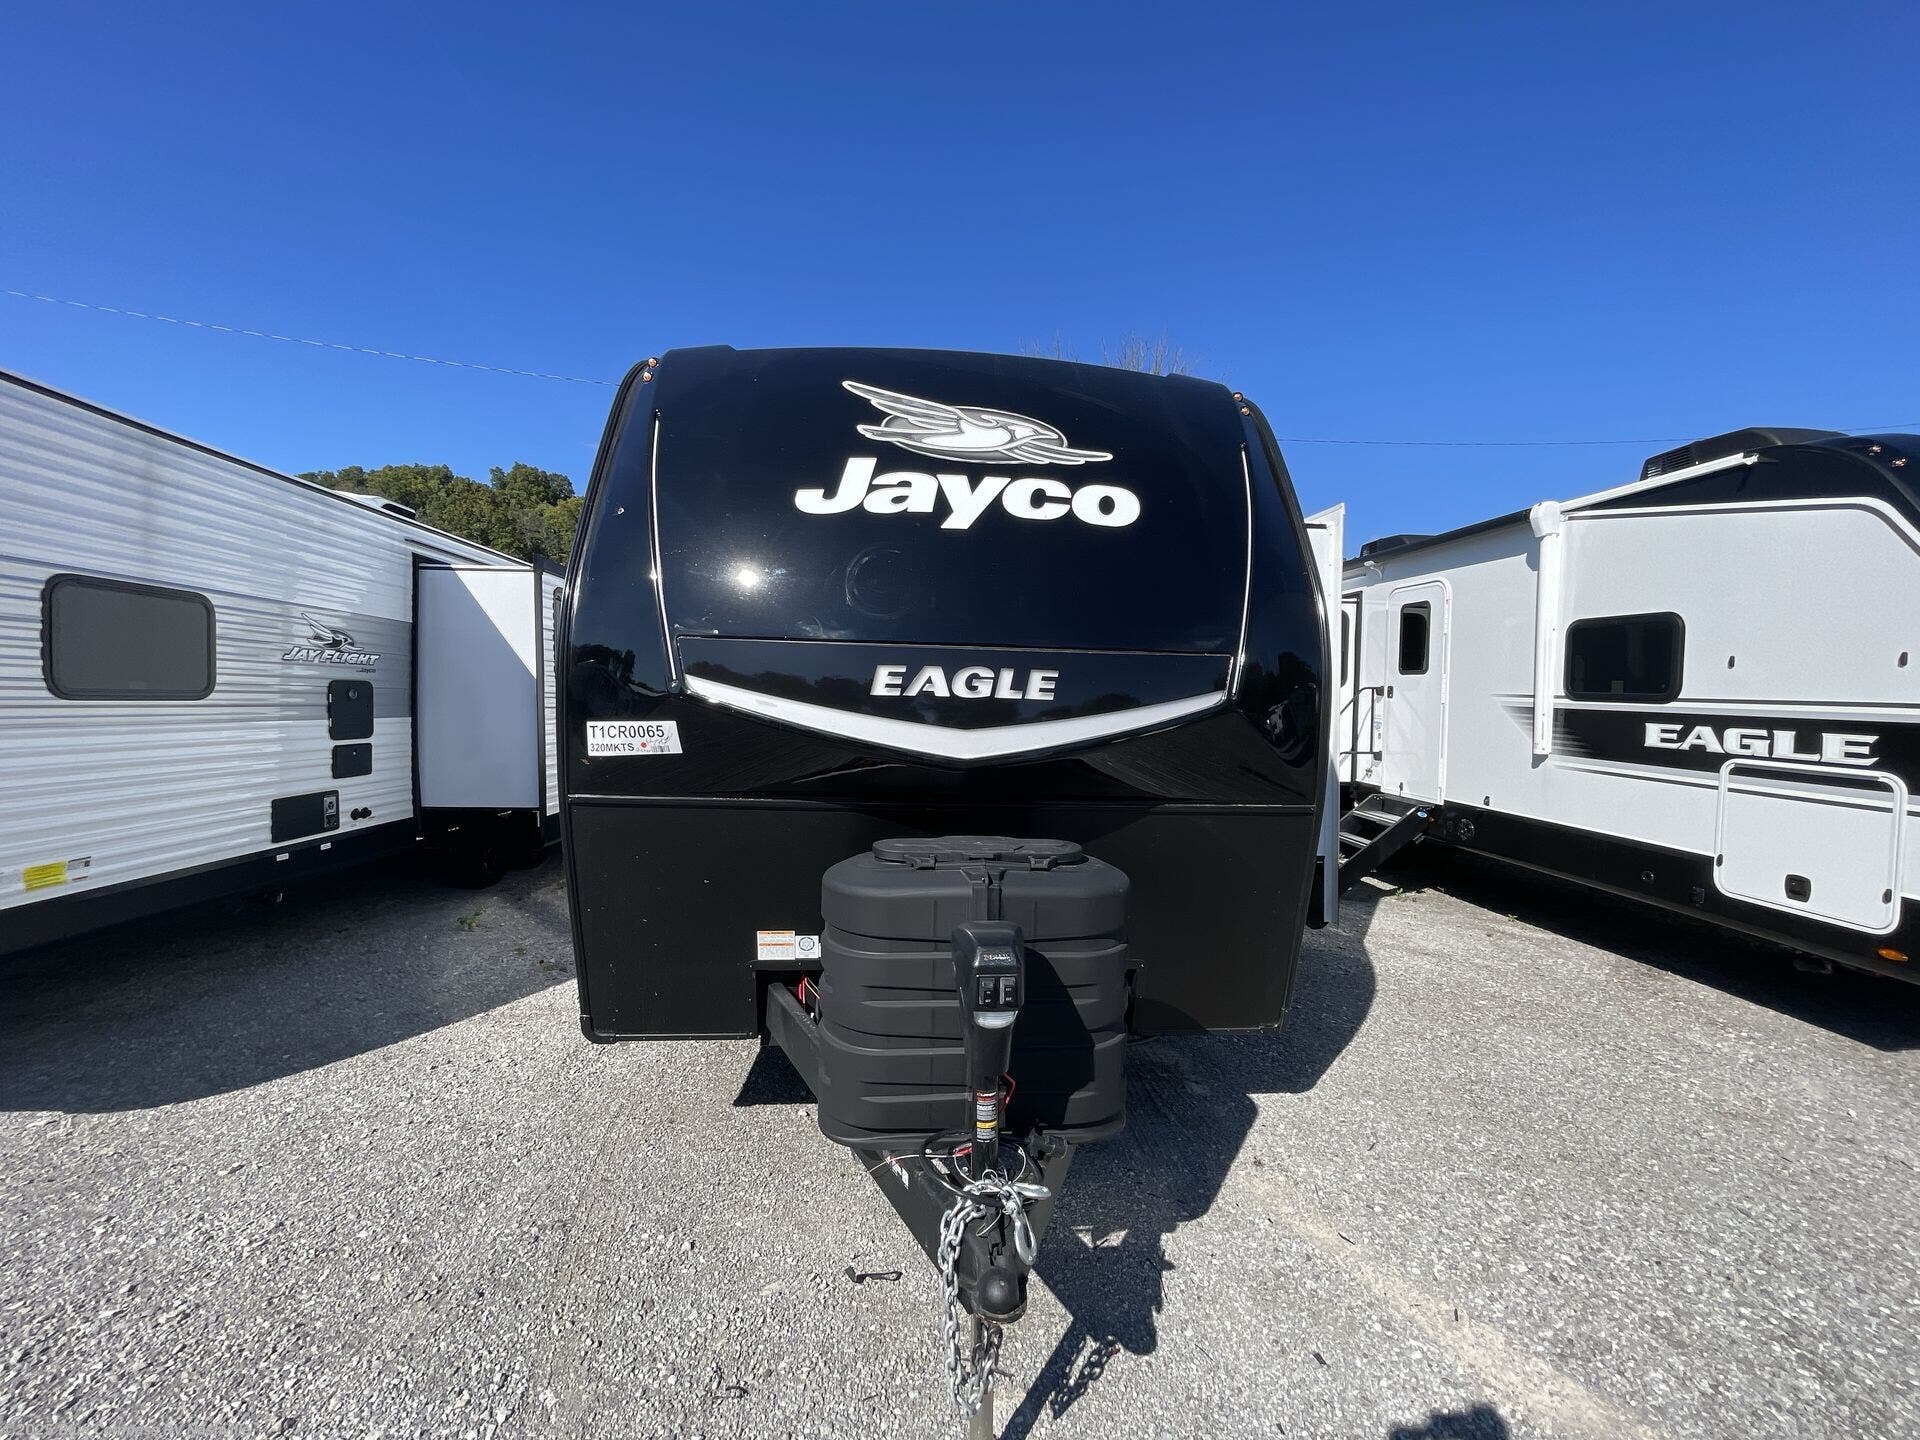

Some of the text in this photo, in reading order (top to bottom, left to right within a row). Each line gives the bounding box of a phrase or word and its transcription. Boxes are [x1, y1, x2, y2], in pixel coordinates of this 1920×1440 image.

[794, 457, 1141, 530] Jayco
[282, 646, 380, 665] JAY FLIGHT
[869, 664, 1060, 701] EAGLE
[589, 725, 665, 739] T1CR0065
[1643, 722, 1880, 766] EAGLE
[590, 742, 635, 752] 320MKTS
